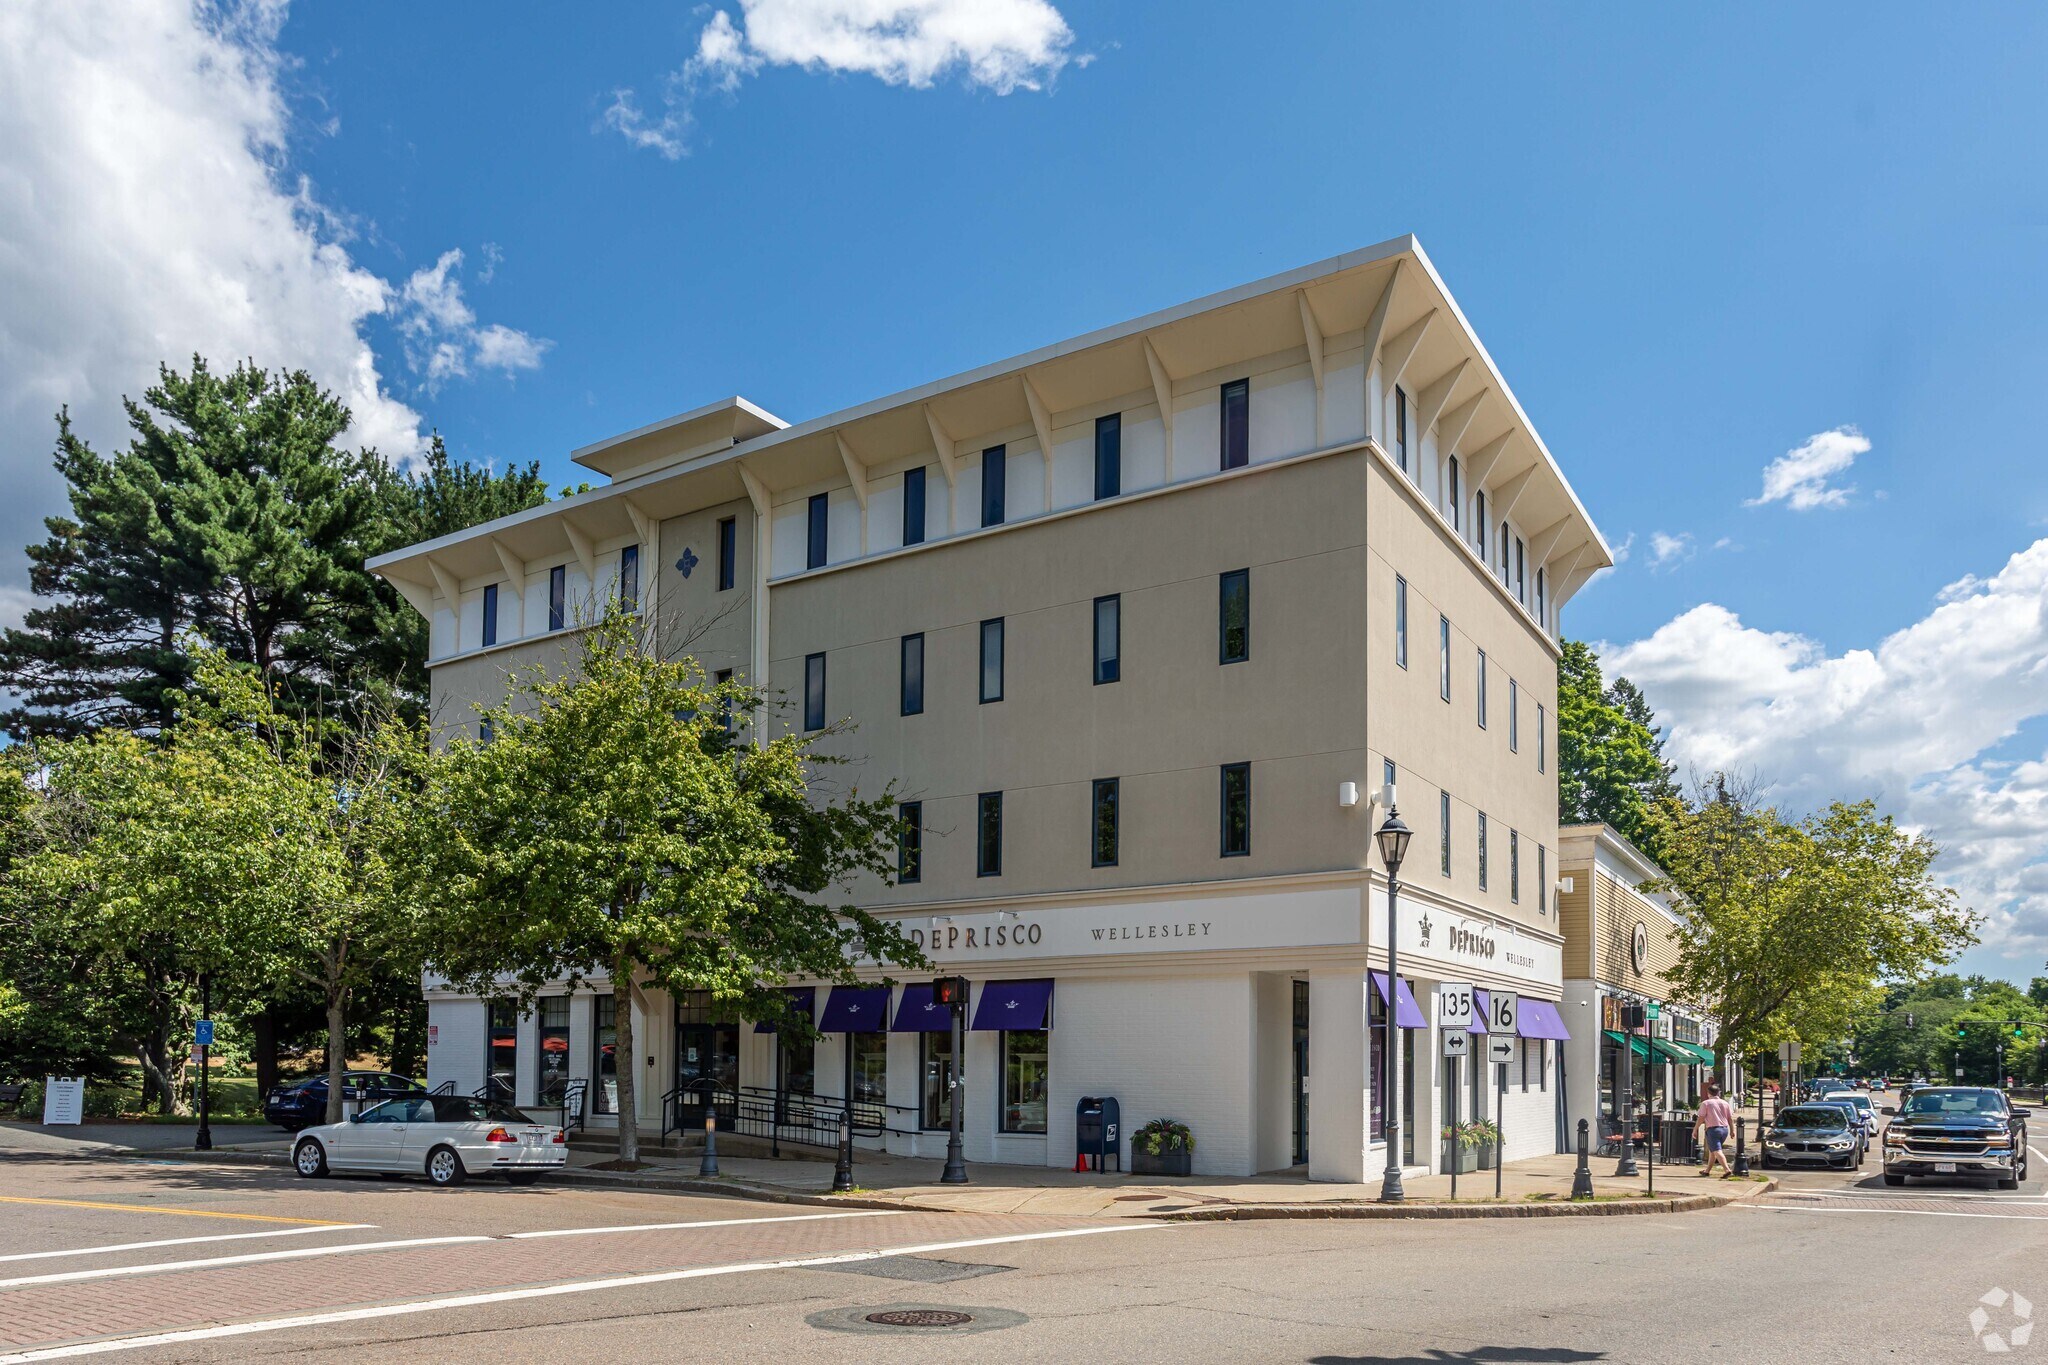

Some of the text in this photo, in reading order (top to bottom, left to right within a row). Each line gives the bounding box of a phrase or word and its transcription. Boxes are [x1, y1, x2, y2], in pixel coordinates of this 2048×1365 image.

[911, 922, 1211, 950] DEPRISCO WELLESLEY
[1449, 925, 1535, 969] DEPRISCO WELLESLEY
[1442, 992, 1470, 1017] 135
[1493, 997, 1513, 1027] 16
